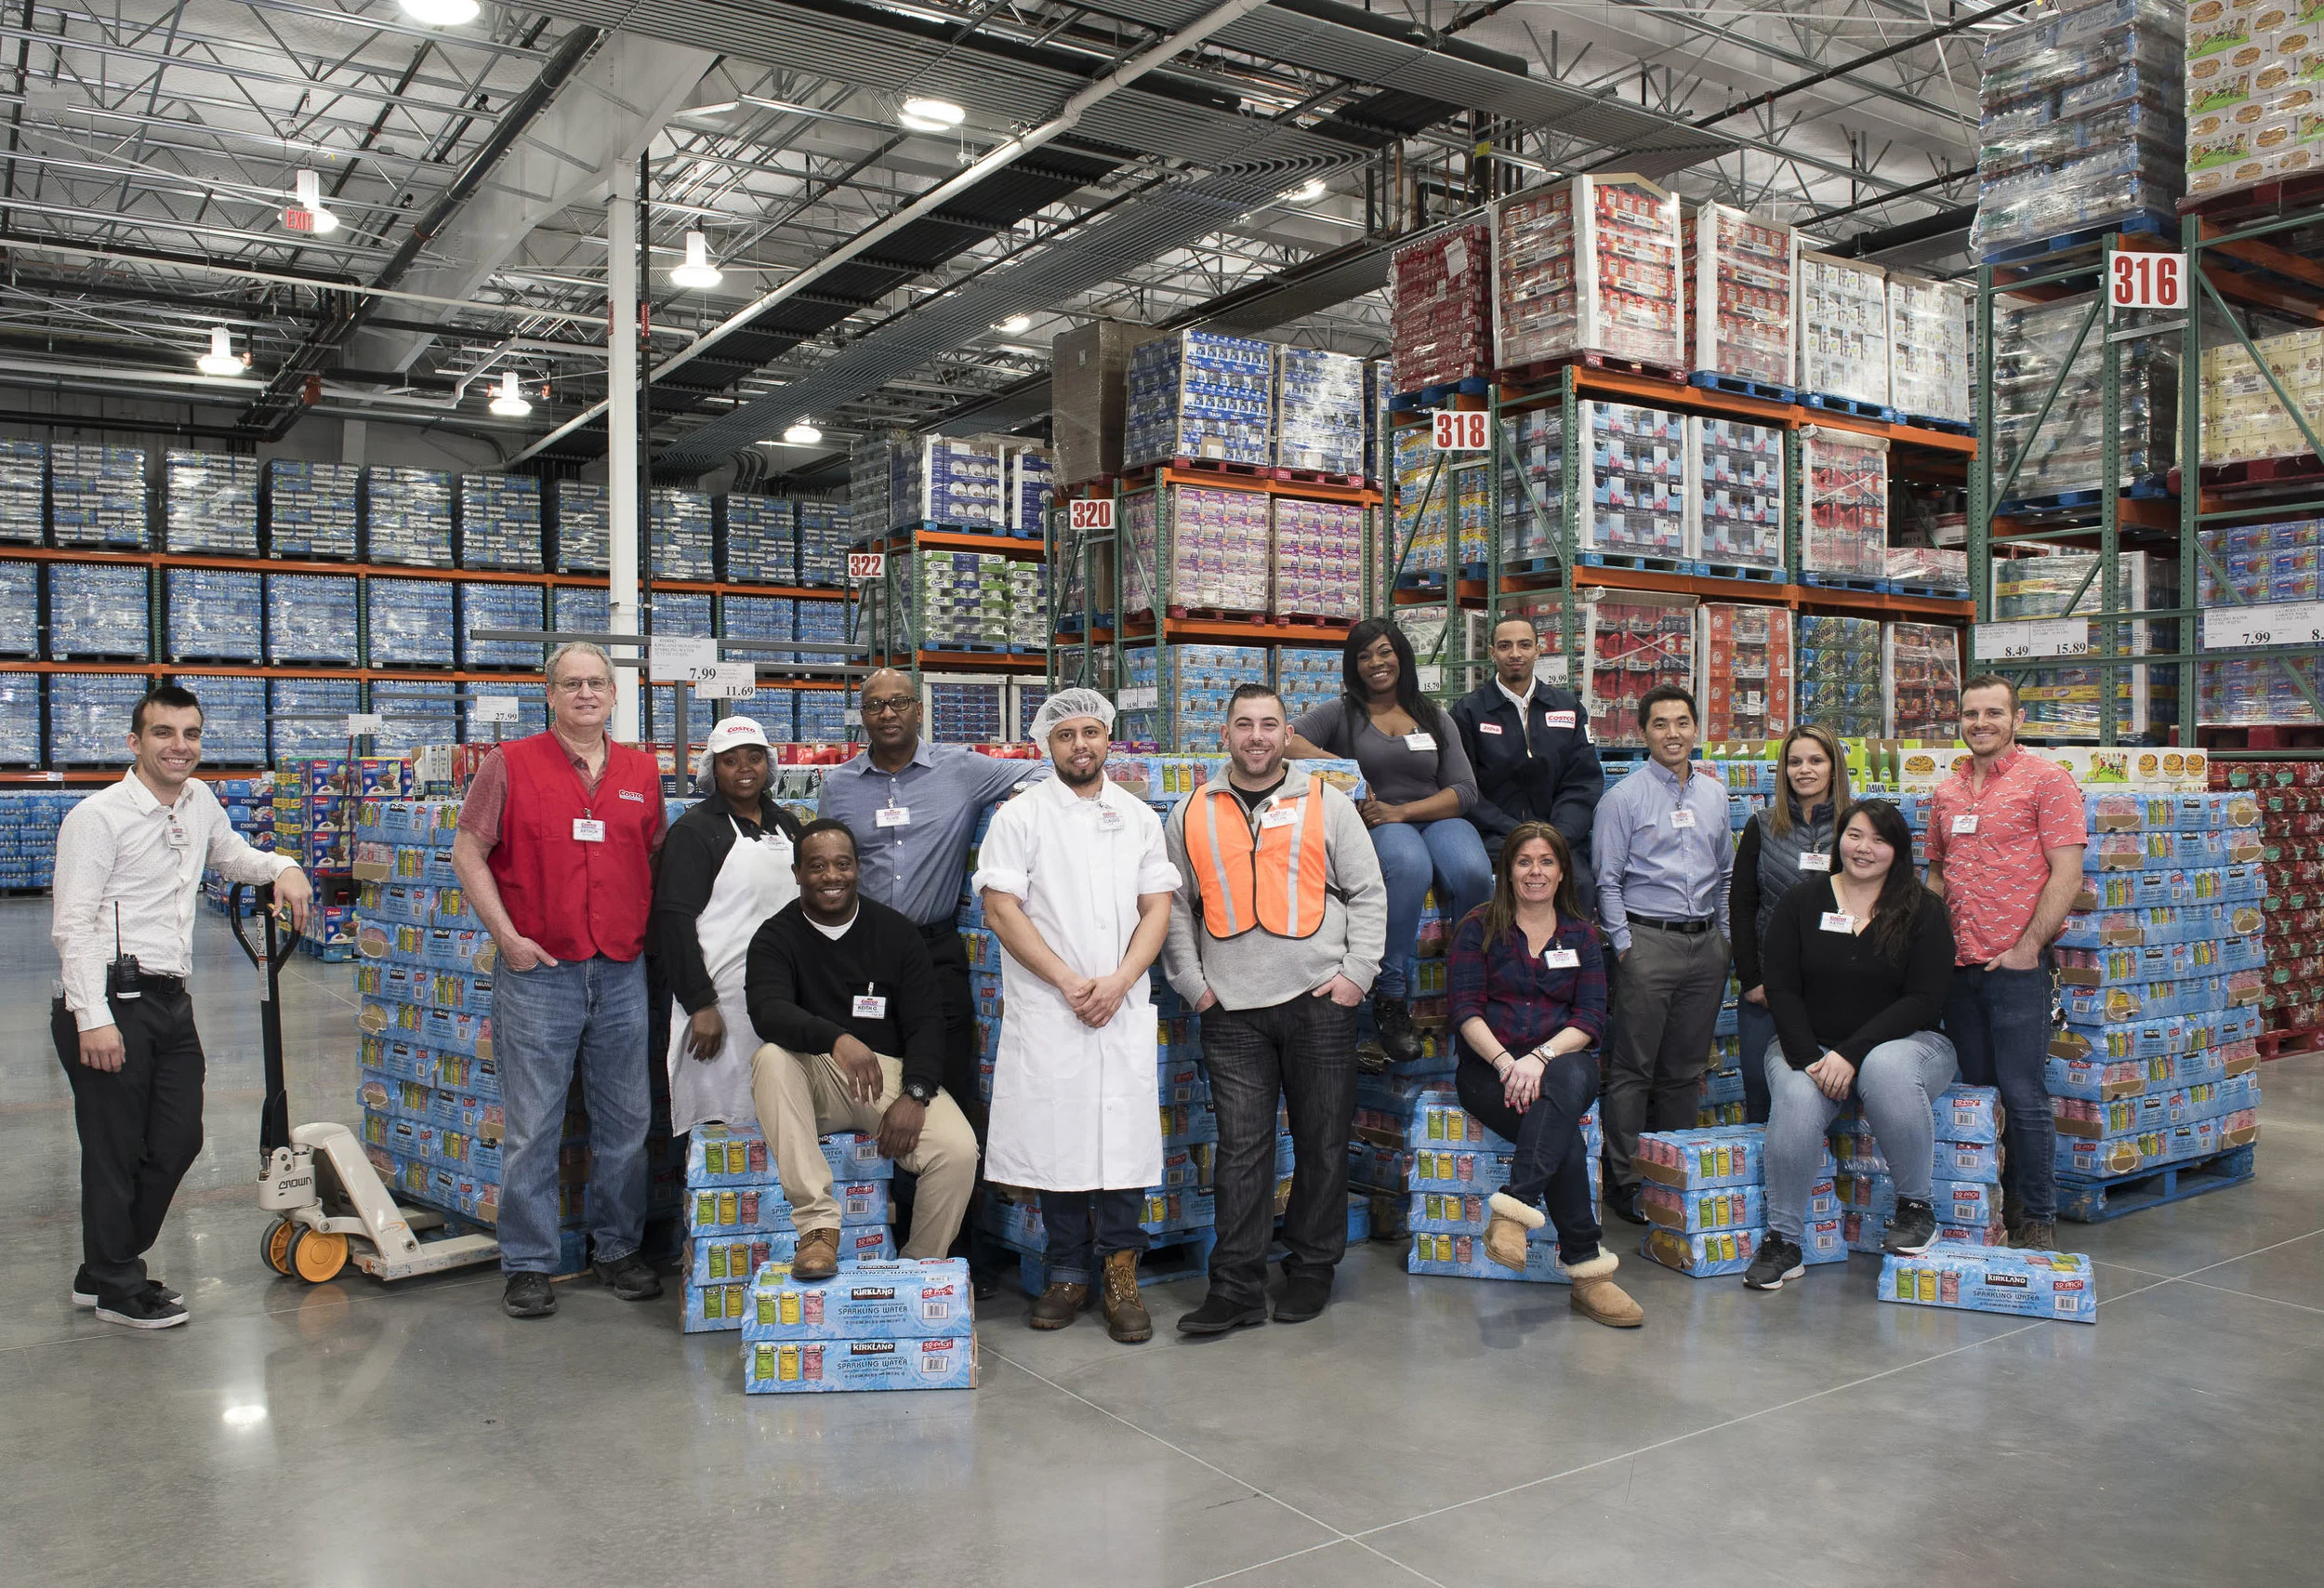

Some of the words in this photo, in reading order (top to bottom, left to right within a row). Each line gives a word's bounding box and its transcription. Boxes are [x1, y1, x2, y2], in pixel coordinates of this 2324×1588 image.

[286, 209, 311, 231] EXIT
[2115, 256, 2177, 305] 316
[1437, 414, 1485, 448] 318
[1401, 486, 1407, 498] 5
[1073, 502, 1111, 527] 320
[851, 556, 881, 576] 322
[2242, 632, 2270, 644] 7.99
[2005, 646, 2028, 656] 8.49
[2056, 642, 2086, 655] 15.89
[690, 668, 716, 680] 7.99
[1548, 675, 1567, 683] 29.99
[726, 686, 753, 695] 11.69
[495, 712, 518, 721] 27.99
[619, 789, 644, 799] COSTCO
[1866, 784, 1886, 793] DAWN
[279, 1177, 312, 1190] CROWN
[1987, 1275, 2026, 1284] KIRKLAND
[853, 1288, 893, 1296] KIRKLAND
[1973, 1291, 2013, 1300] SPARKLING
[2015, 1293, 2040, 1302] WATER
